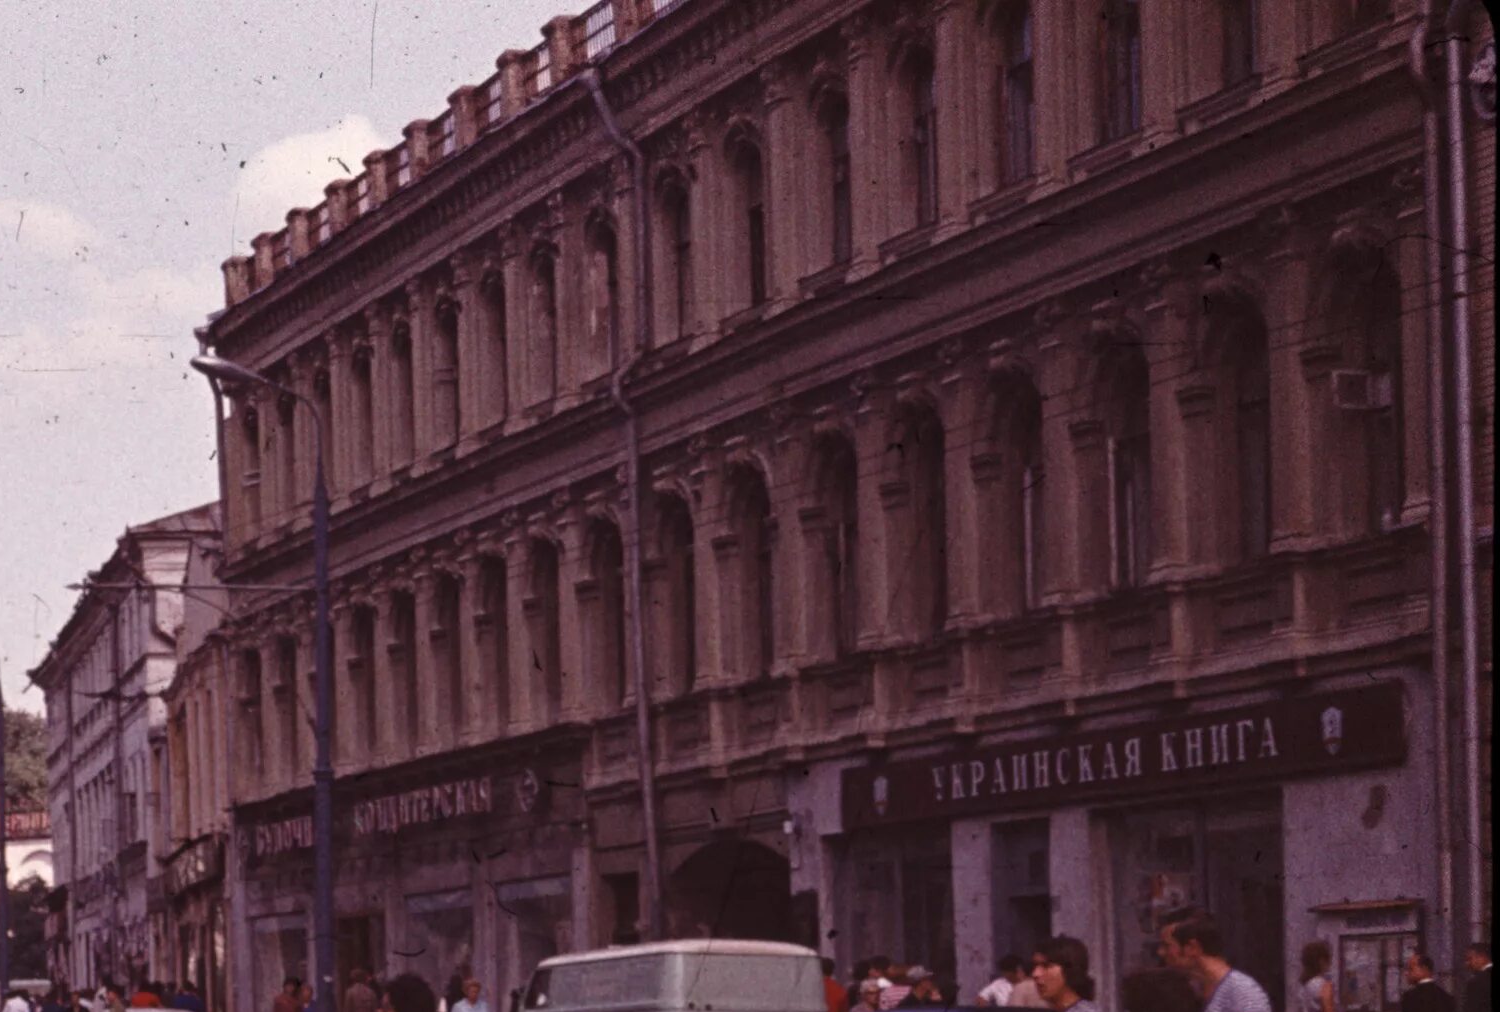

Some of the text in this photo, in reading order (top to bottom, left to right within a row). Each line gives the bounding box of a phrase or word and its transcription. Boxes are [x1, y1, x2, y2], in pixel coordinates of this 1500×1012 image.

[931, 716, 1280, 801] УКРАИНСКАЯ КНИГА
[256, 815, 313, 857] БУЛОЧН
